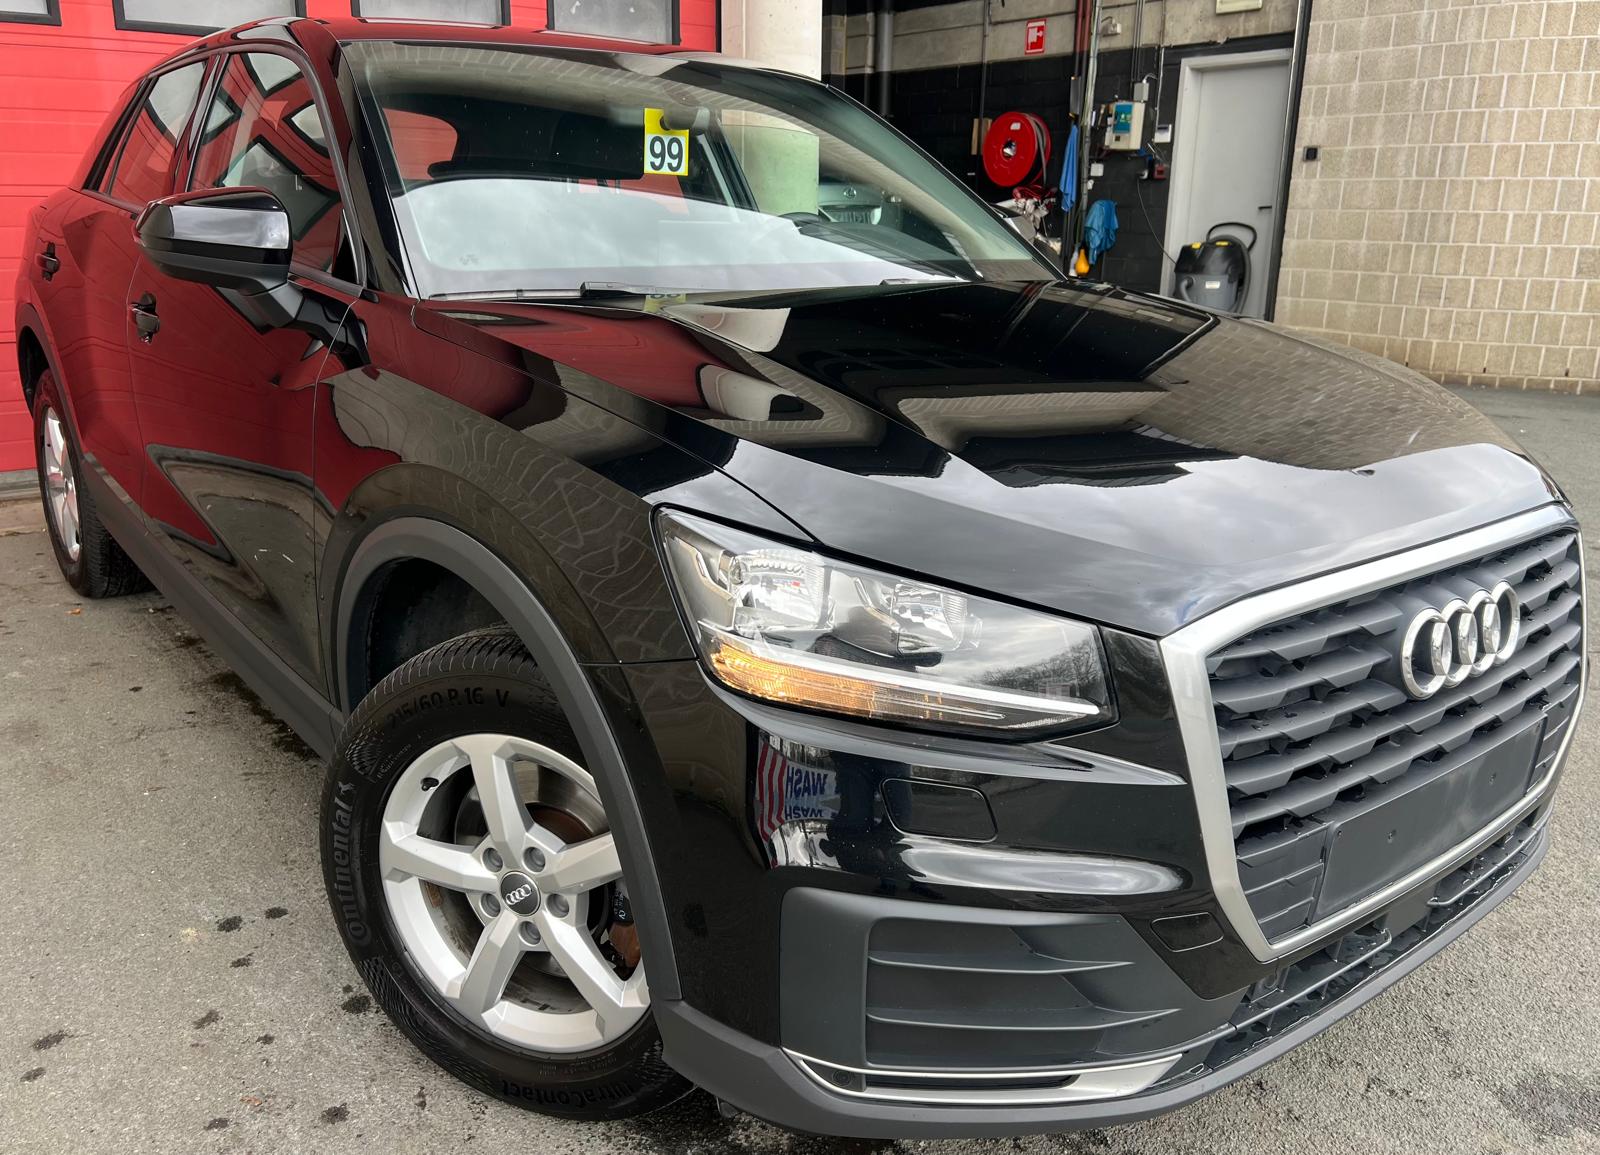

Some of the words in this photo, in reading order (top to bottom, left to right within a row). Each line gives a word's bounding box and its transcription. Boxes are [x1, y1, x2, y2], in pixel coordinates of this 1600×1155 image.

[649, 135, 683, 172] 99
[464, 687, 483, 705] 16
[495, 688, 509, 708] V
[331, 797, 371, 946] Continental
